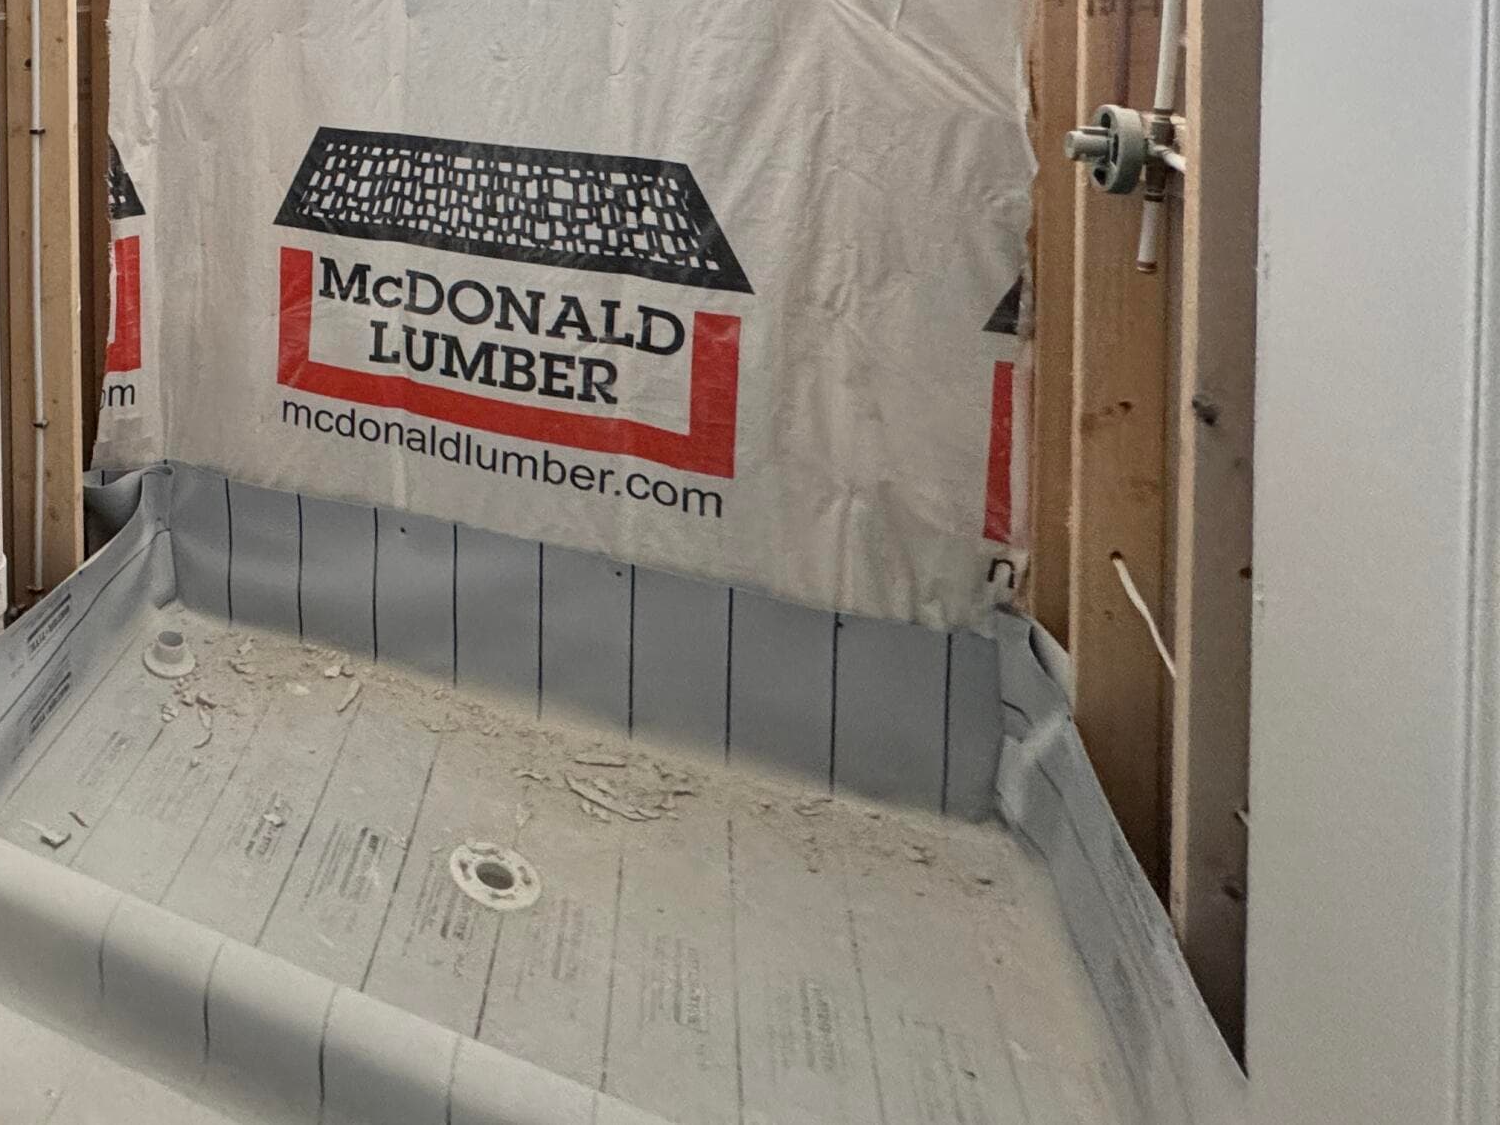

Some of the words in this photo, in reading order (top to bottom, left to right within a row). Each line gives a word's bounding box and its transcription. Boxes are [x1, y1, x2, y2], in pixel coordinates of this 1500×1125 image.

[318, 256, 686, 356] McDONALD
[368, 320, 619, 405] LUMBER
[282, 398, 723, 519] mcdonaldlumber.com
